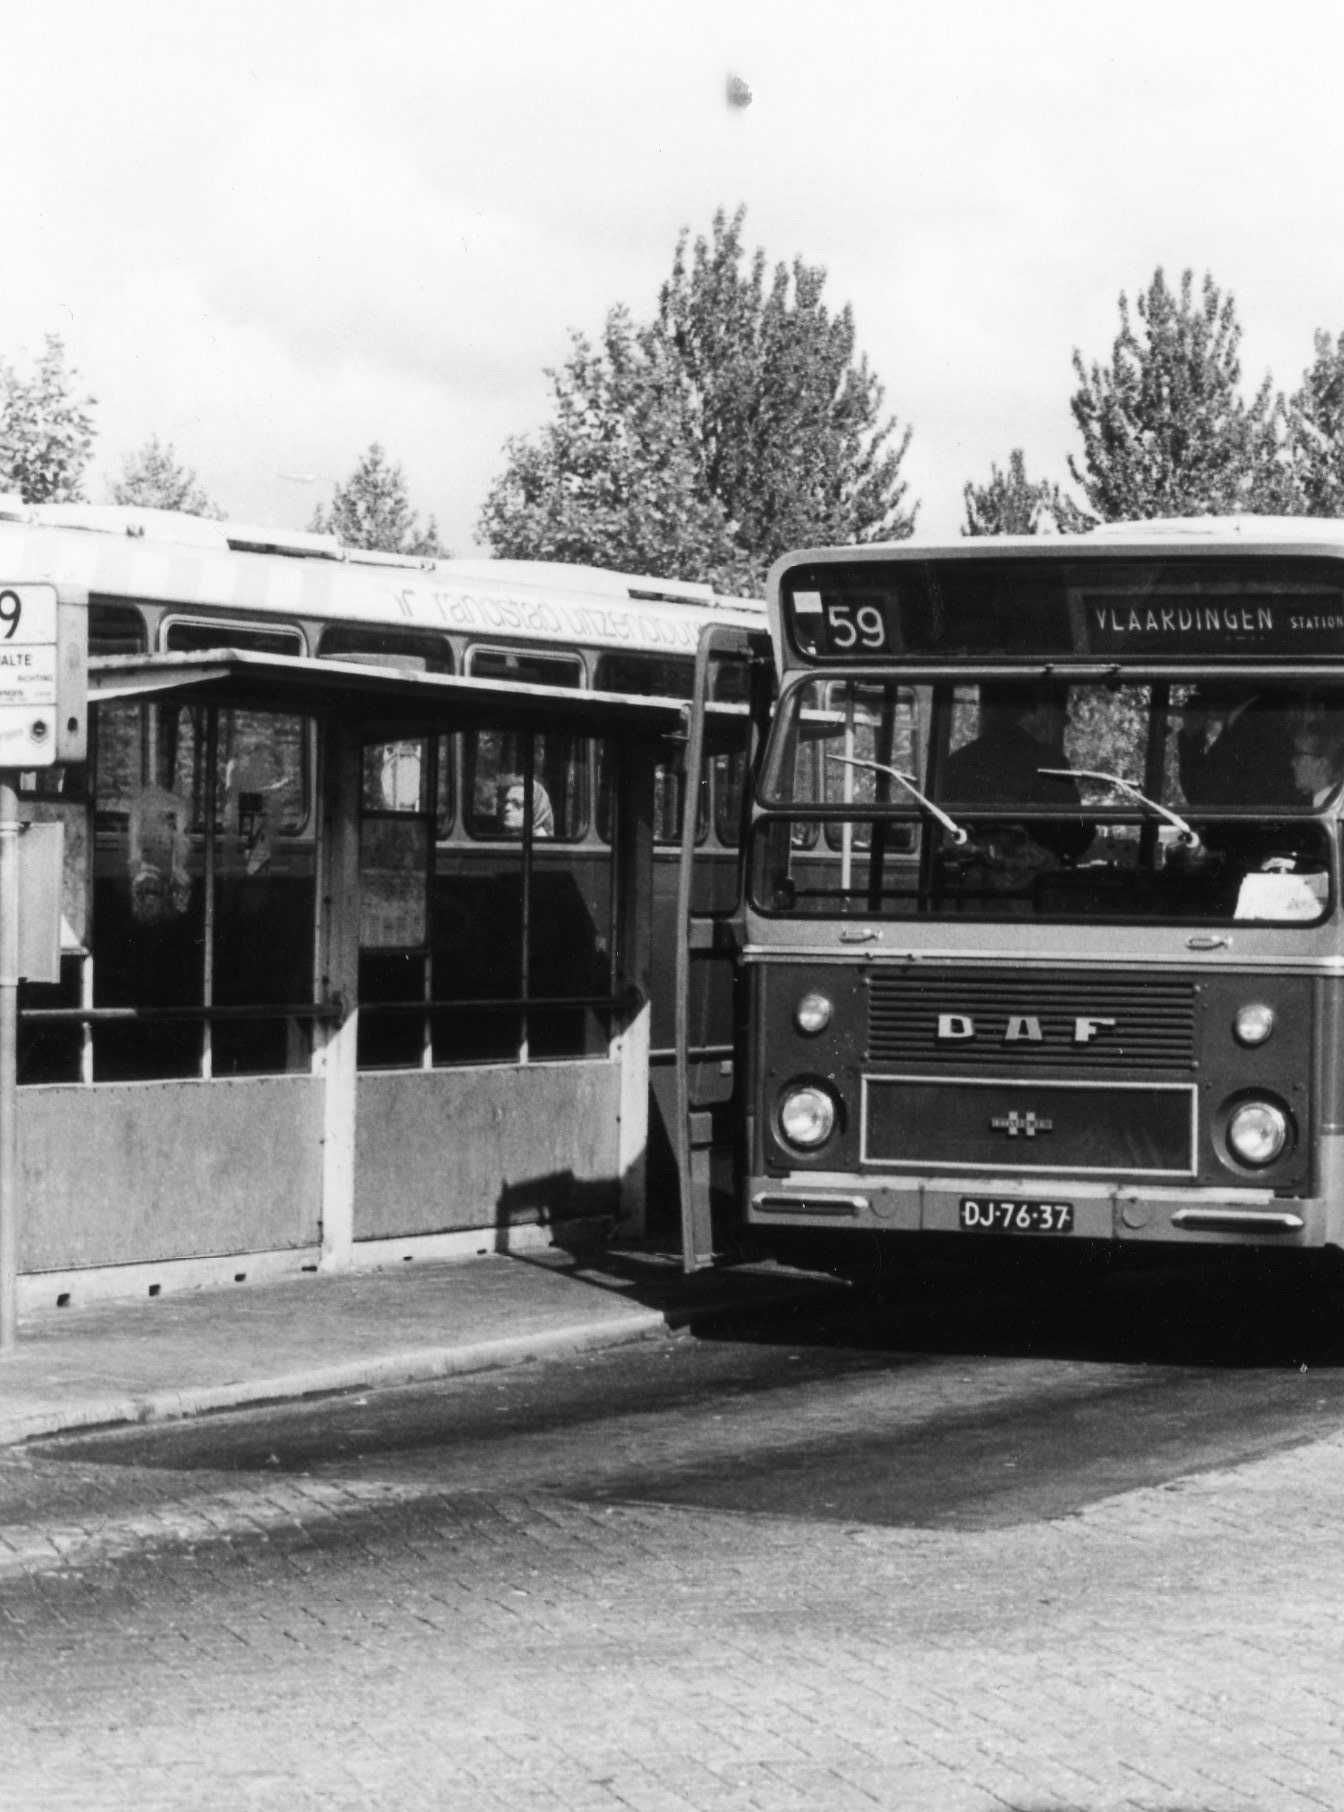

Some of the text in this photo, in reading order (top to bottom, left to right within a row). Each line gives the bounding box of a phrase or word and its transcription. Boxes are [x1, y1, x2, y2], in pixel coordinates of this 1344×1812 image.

[828, 606, 885, 648] 59
[1096, 607, 1344, 631] VLAARDINGEN STATION
[0, 653, 32, 666] ALTE
[937, 1013, 1117, 1043] DAF
